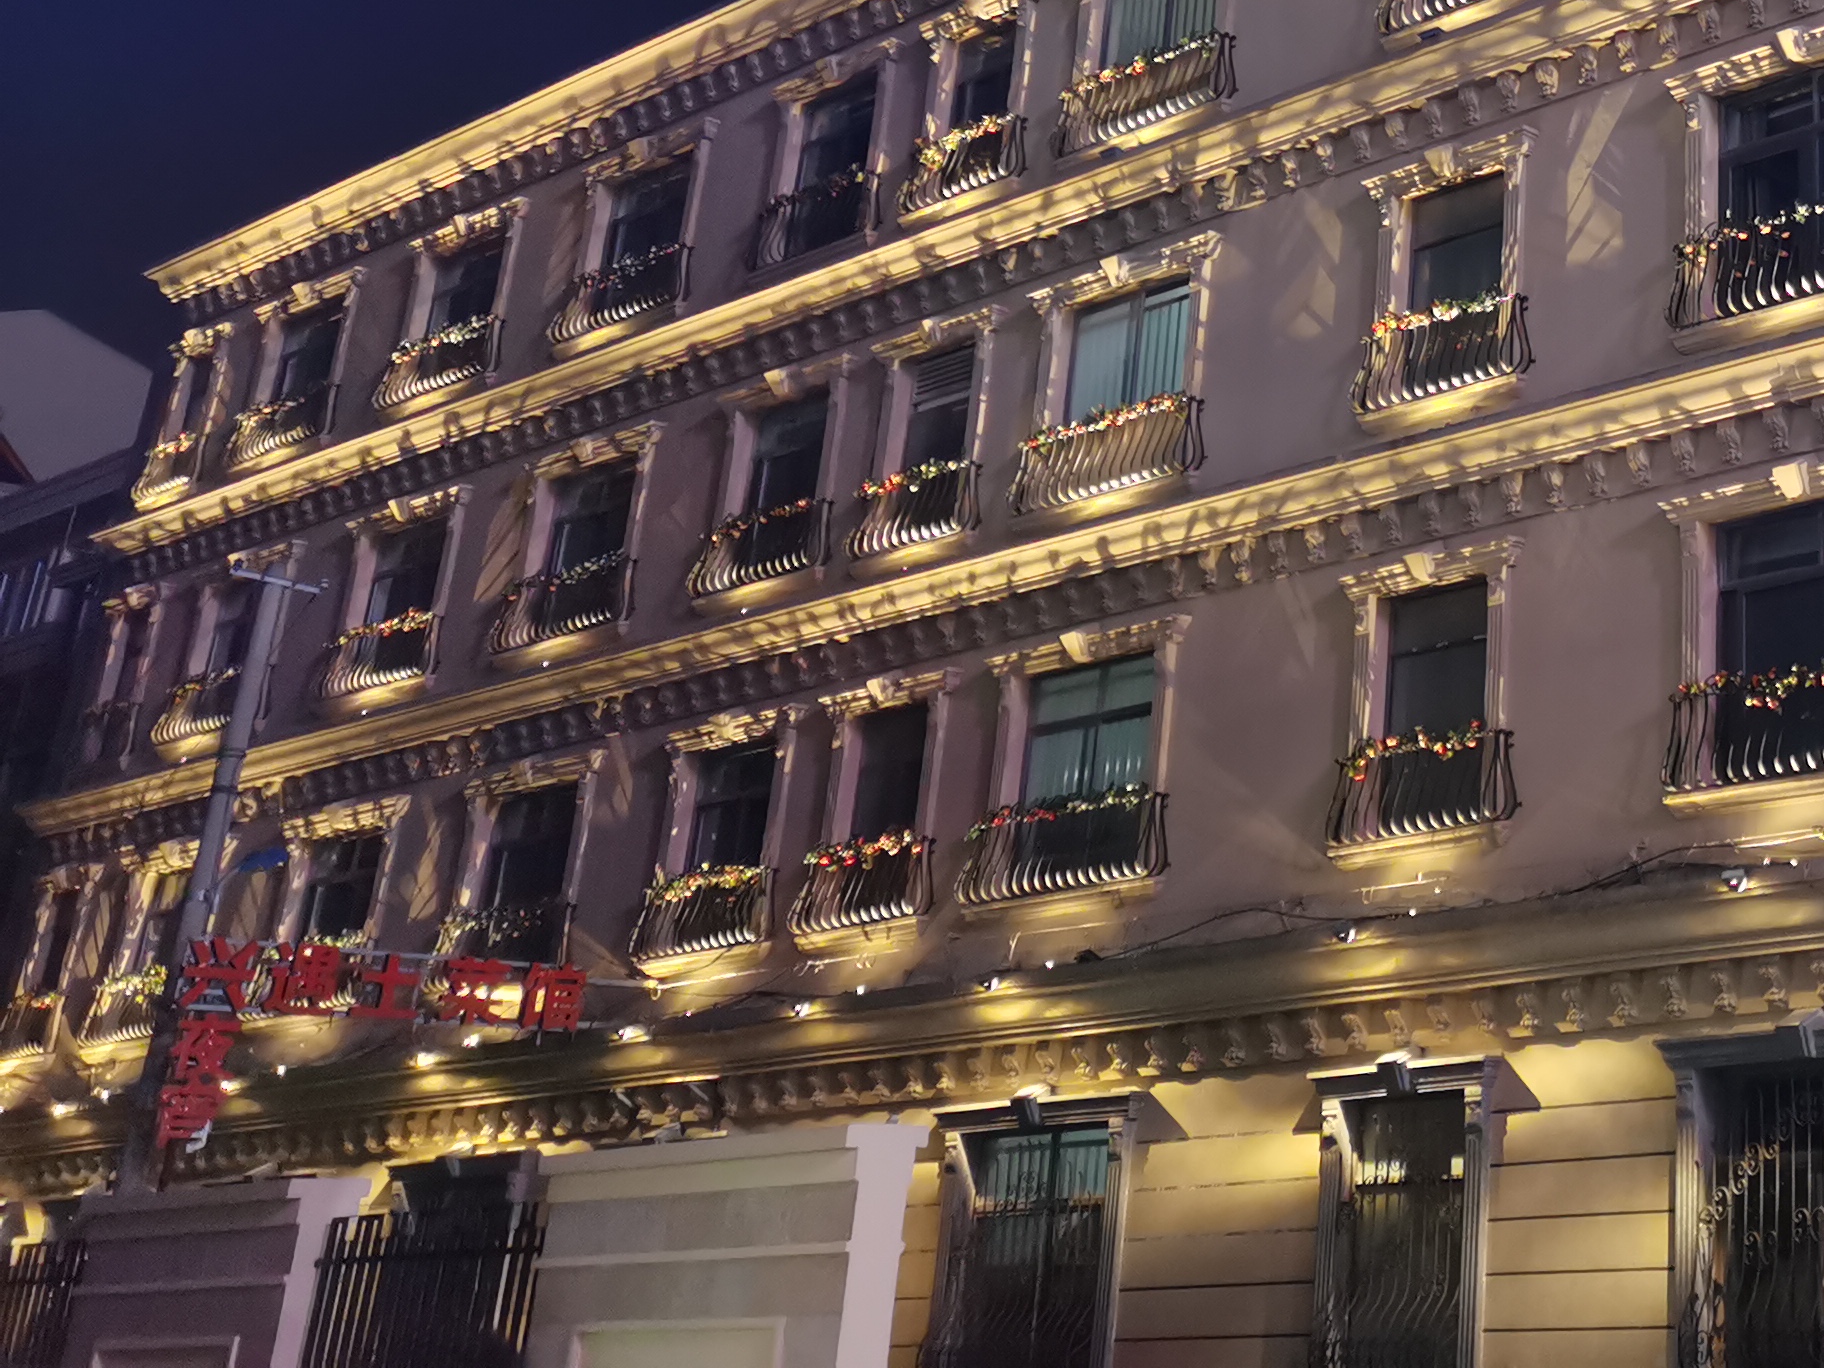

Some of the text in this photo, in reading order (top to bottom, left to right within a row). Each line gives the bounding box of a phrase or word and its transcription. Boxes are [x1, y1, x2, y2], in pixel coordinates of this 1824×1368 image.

[180, 935, 587, 1031] 兴遇土菜馆
